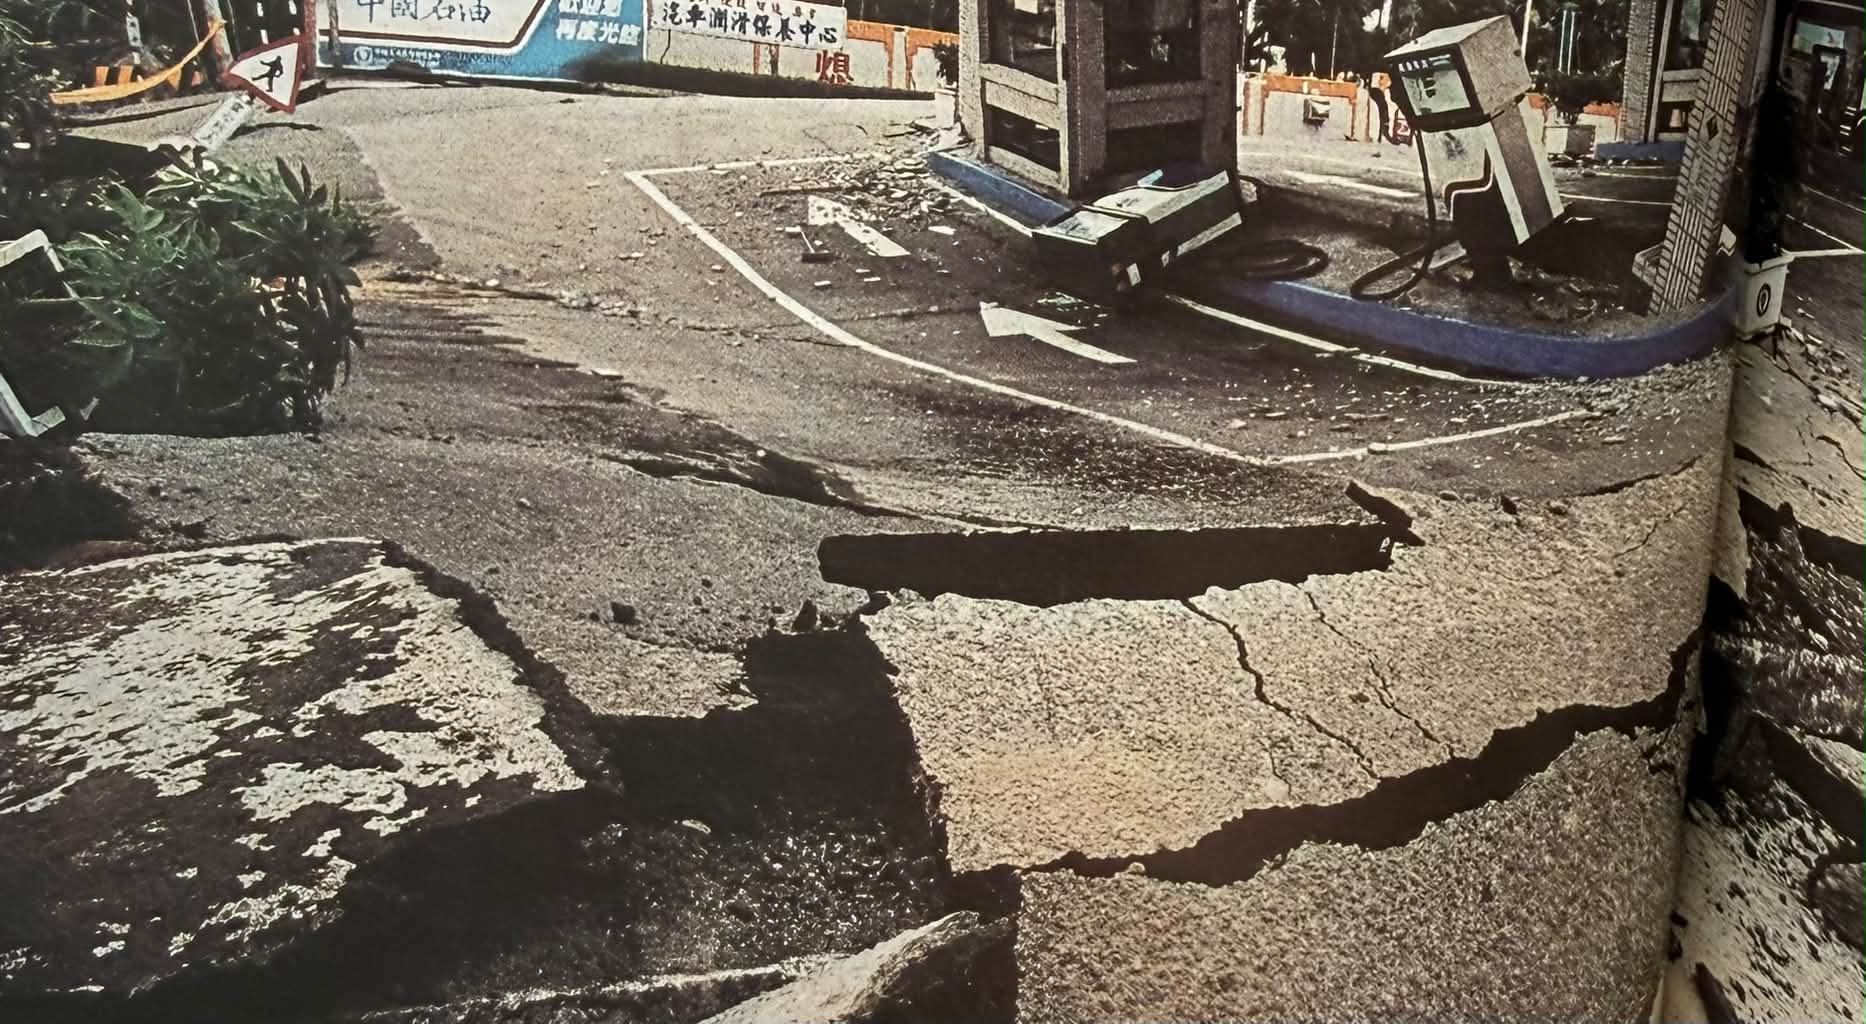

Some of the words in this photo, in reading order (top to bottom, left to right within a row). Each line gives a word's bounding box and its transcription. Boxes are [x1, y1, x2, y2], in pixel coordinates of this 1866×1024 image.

[662, 1, 838, 45] 汽車潤滑保養中心
